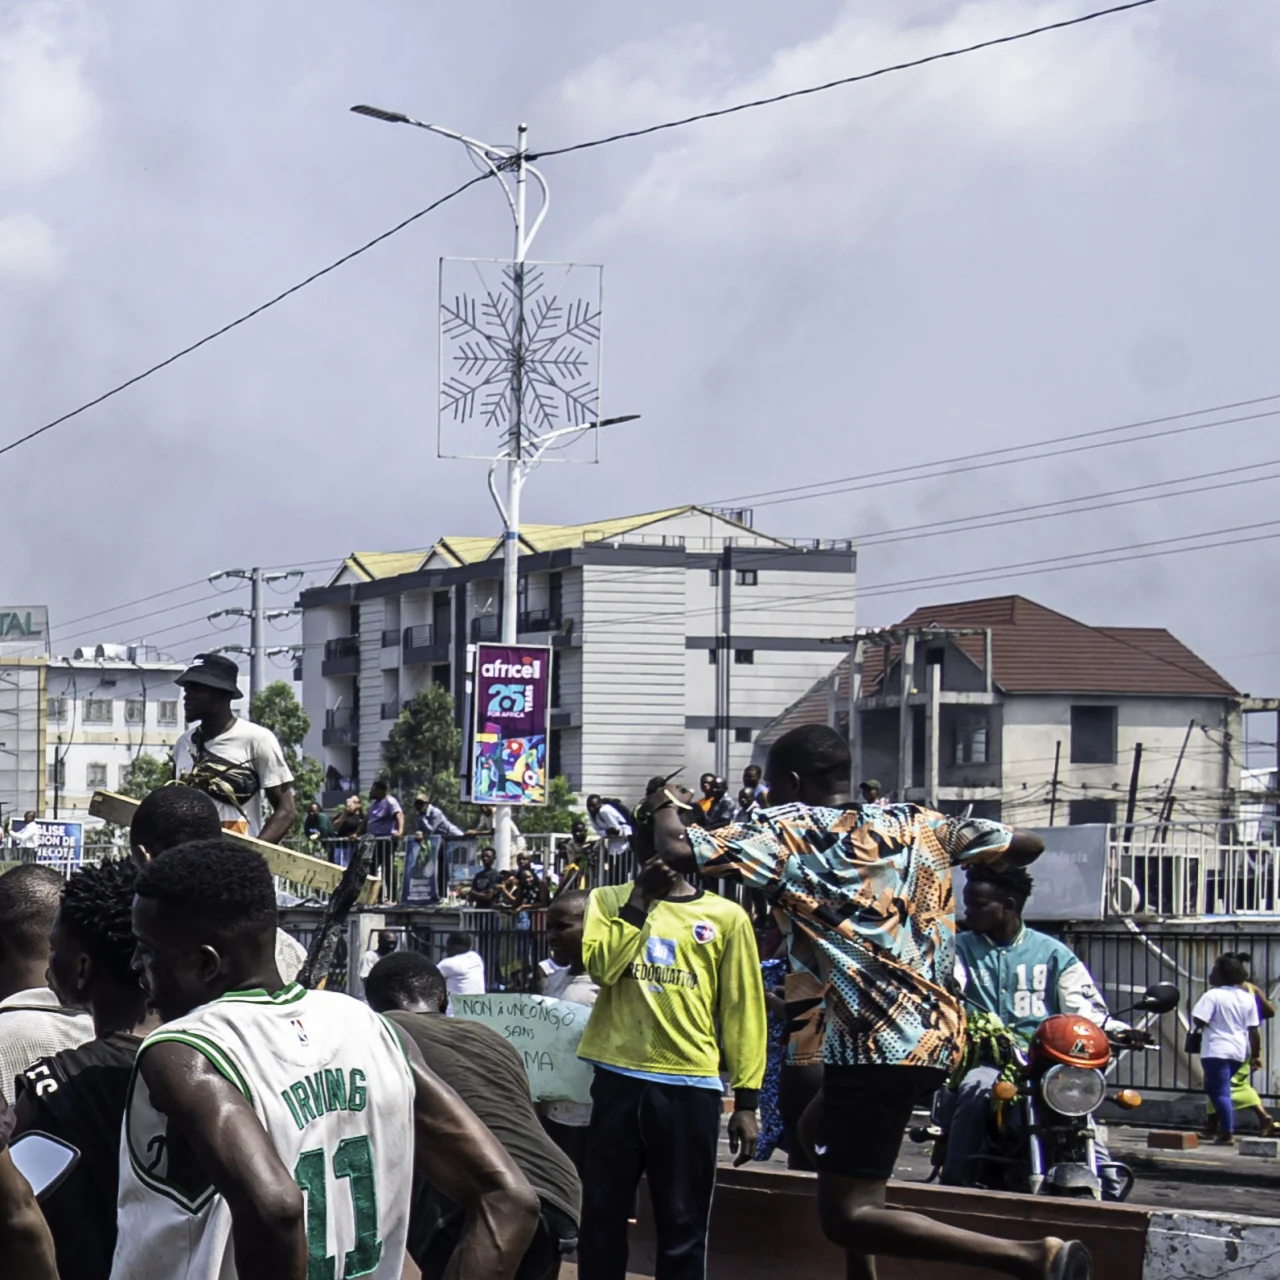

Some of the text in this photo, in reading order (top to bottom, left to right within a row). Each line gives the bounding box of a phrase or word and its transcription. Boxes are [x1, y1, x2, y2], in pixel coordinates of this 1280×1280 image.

[488, 683, 526, 713] 25
[1016, 964, 1048, 991] 18
[463, 999, 492, 1017] NON
[1014, 990, 1047, 1018] 86
[504, 1025, 535, 1040] SANS
[523, 1050, 554, 1072] MA
[281, 1067, 367, 1131] IRVING
